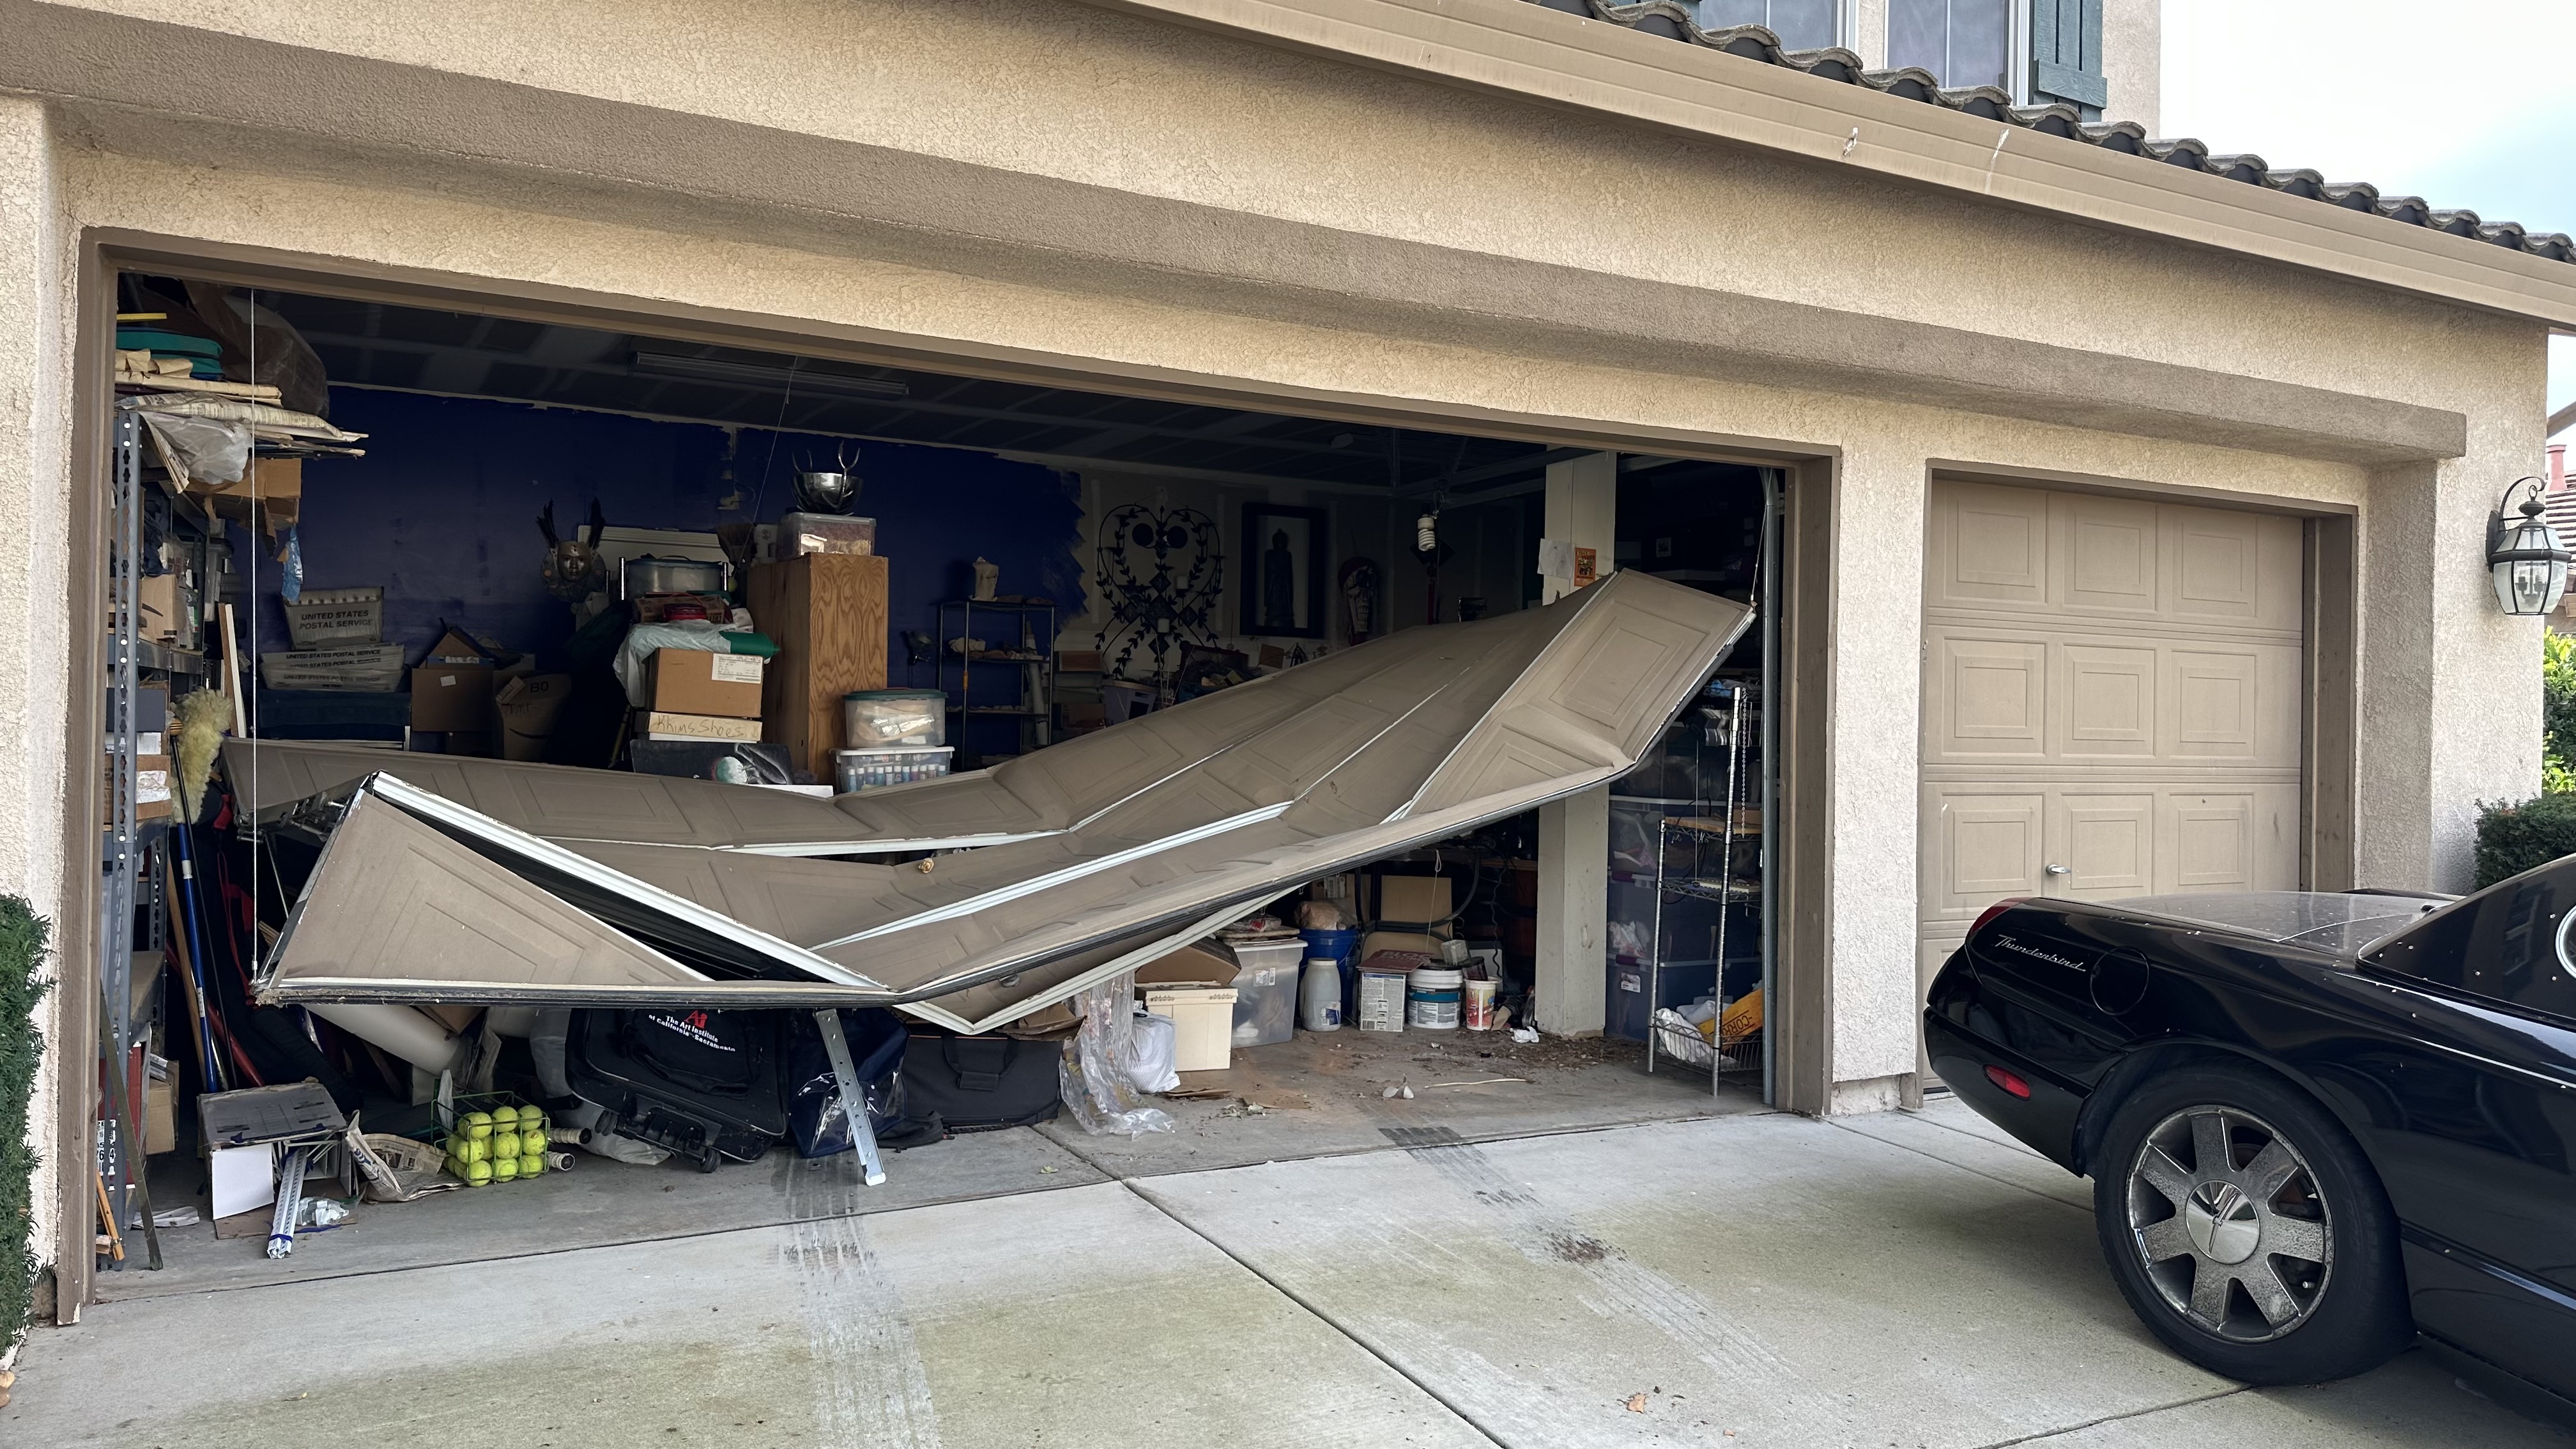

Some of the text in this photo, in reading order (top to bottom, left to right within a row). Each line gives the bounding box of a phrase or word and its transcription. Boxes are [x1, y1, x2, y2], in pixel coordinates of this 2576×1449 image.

[299, 618, 373, 630] POSTAL SERVICE
[301, 610, 369, 620] UNITED STATES
[698, 719, 744, 738] Shoes
[1994, 933, 2087, 972] Thunderbird
[656, 1018, 689, 1037] California
[666, 1015, 718, 1043] The Art Institute
